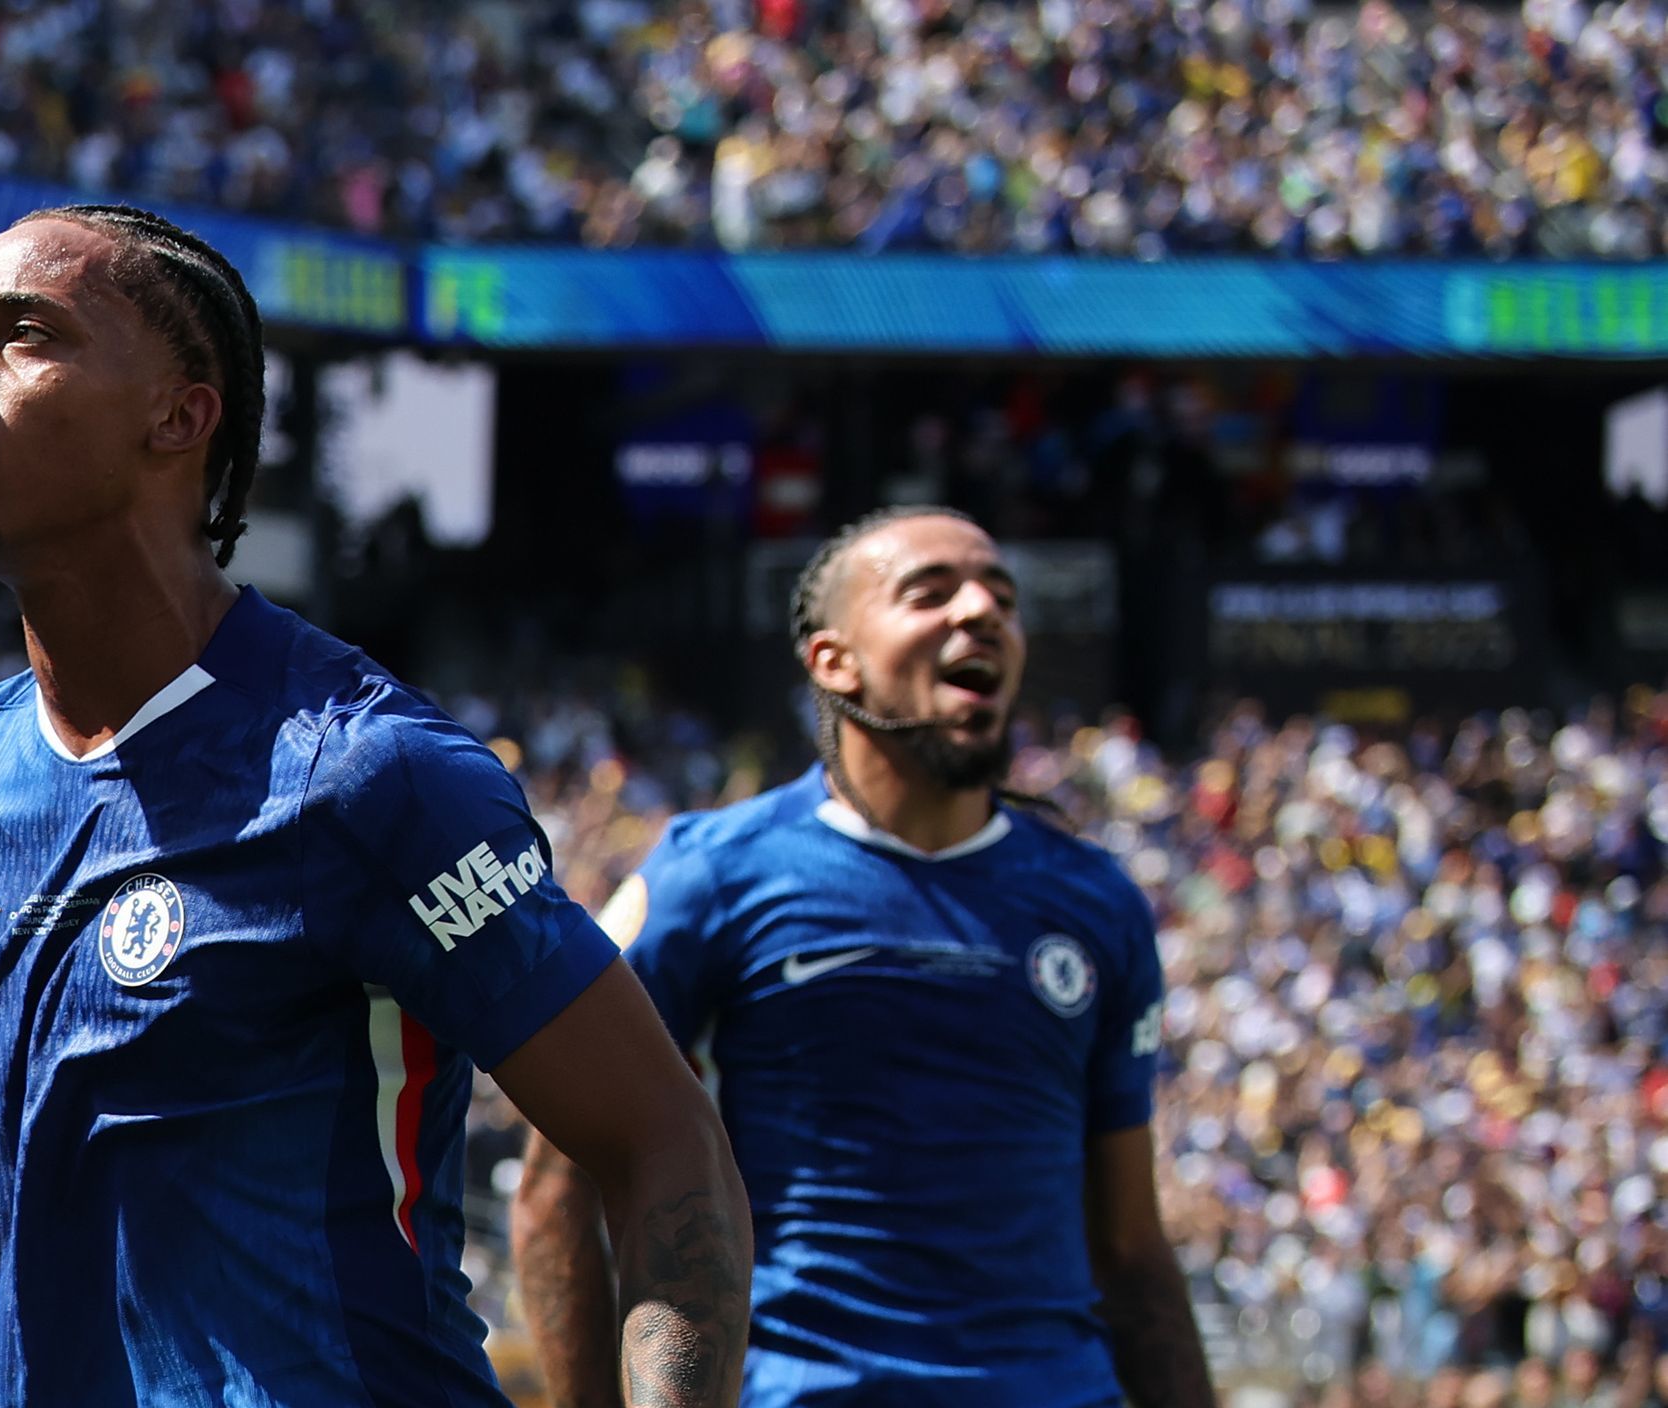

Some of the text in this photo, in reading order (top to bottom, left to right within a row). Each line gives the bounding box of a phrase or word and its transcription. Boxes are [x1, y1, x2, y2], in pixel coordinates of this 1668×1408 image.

[126, 877, 176, 908] CHELSEA
[408, 840, 503, 926] LIVE
[428, 838, 547, 952] NATION
[105, 952, 157, 979] FOOTBALL CLUB
